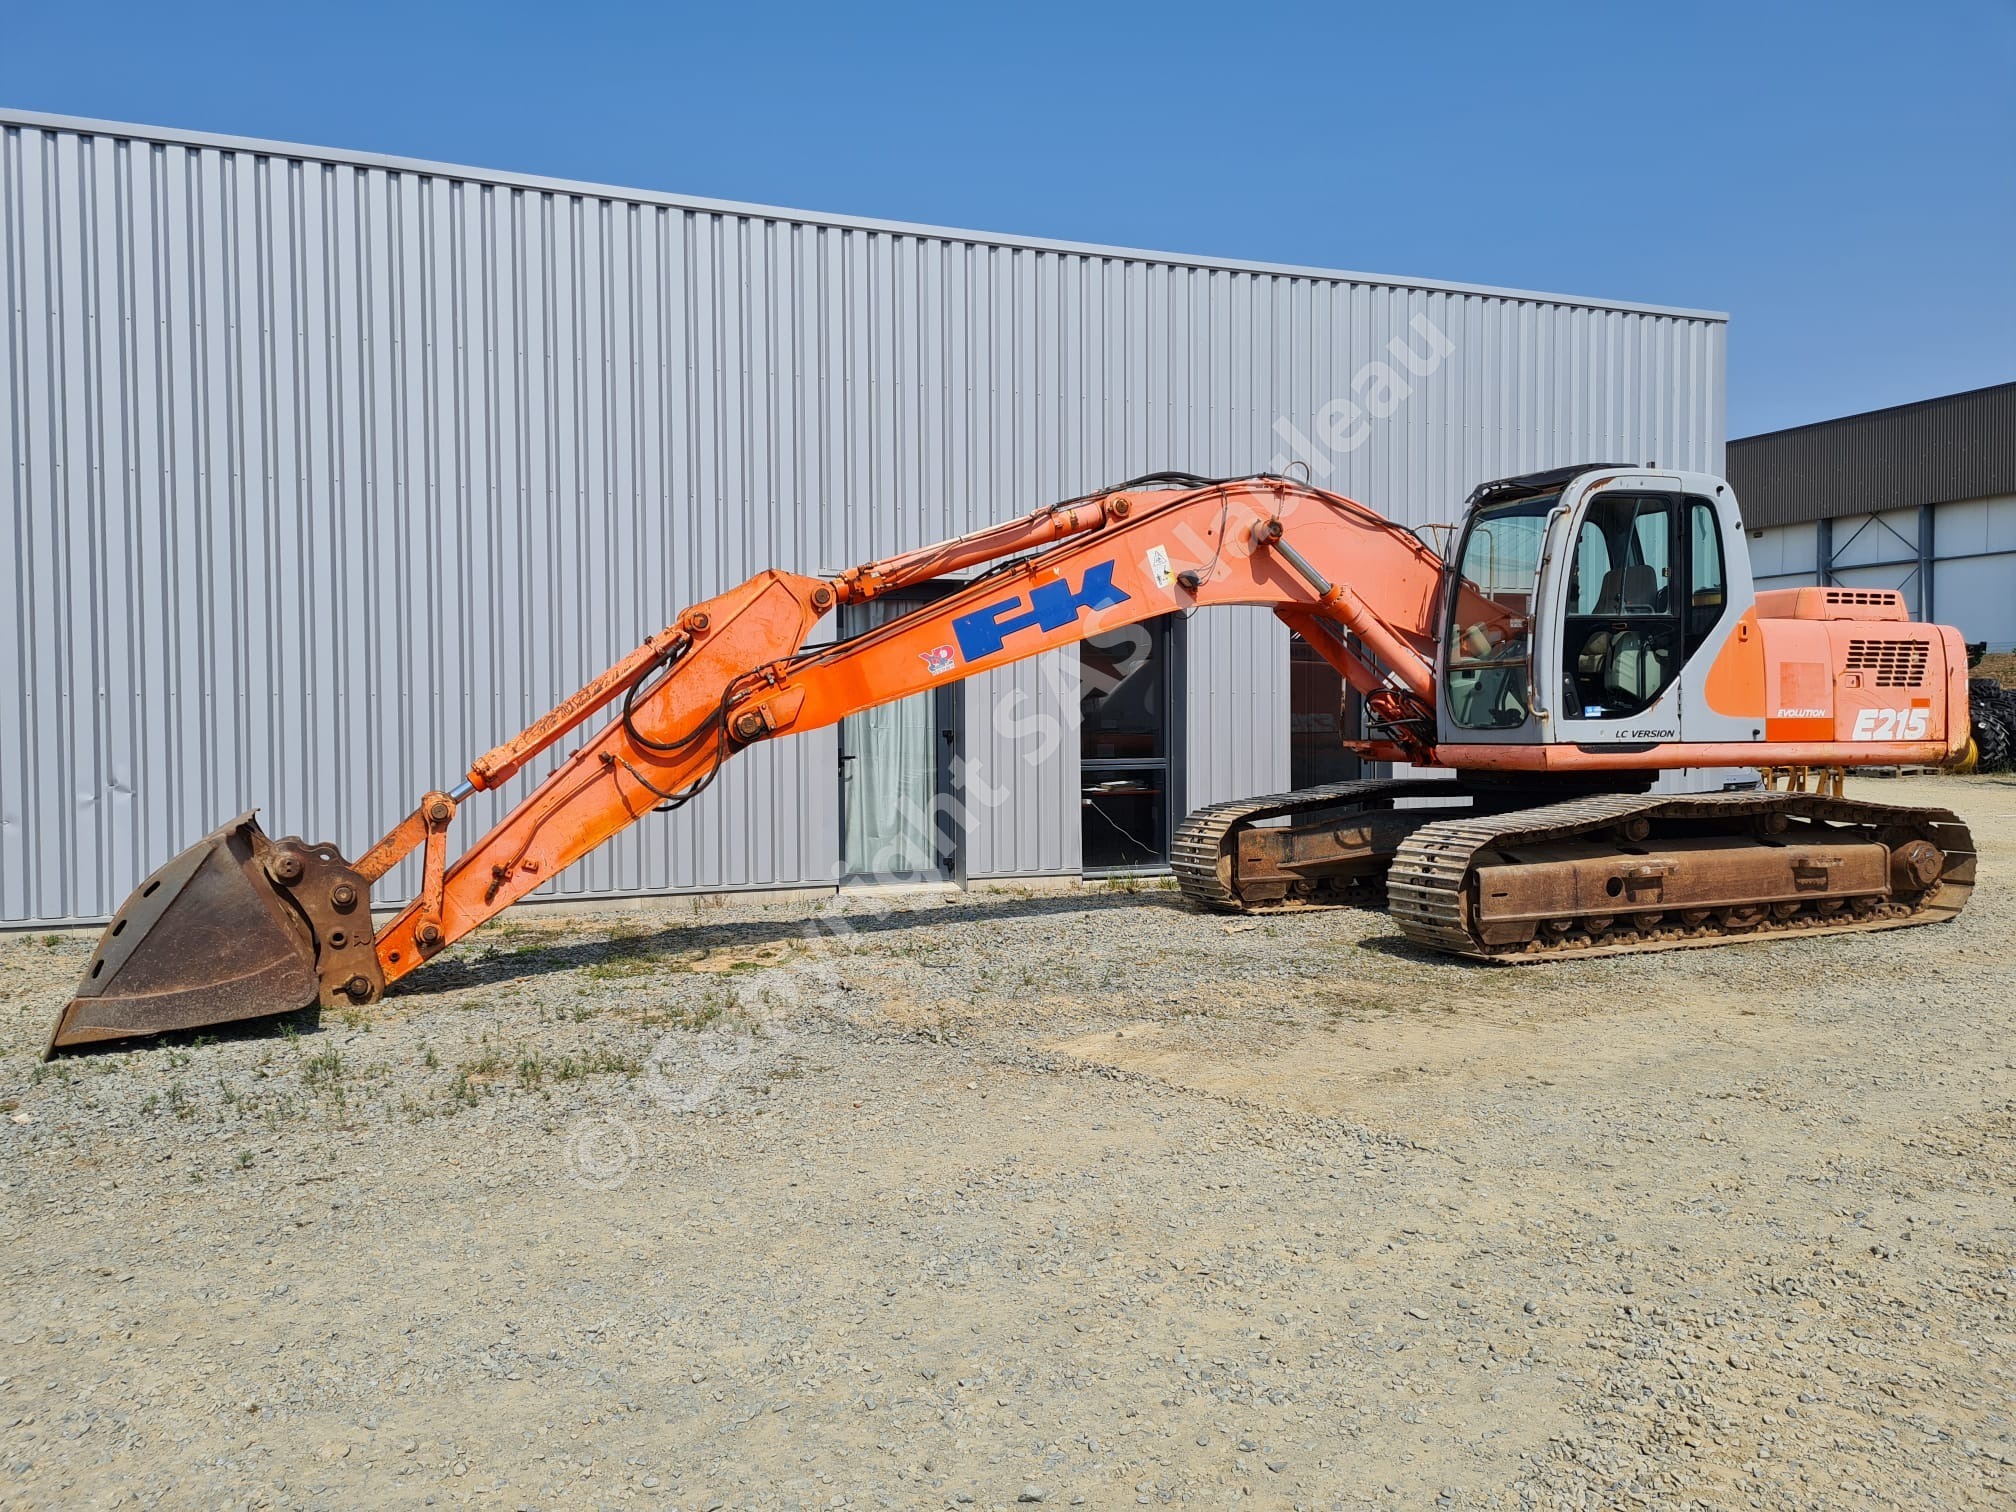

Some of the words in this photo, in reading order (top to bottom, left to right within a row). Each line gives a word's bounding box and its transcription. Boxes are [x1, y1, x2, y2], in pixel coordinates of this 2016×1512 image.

[1777, 708, 1826, 718] EVOLUTION
[1852, 708, 1930, 741] E215
[1615, 730, 1629, 739] LC
[1631, 729, 1676, 739] VERSION
